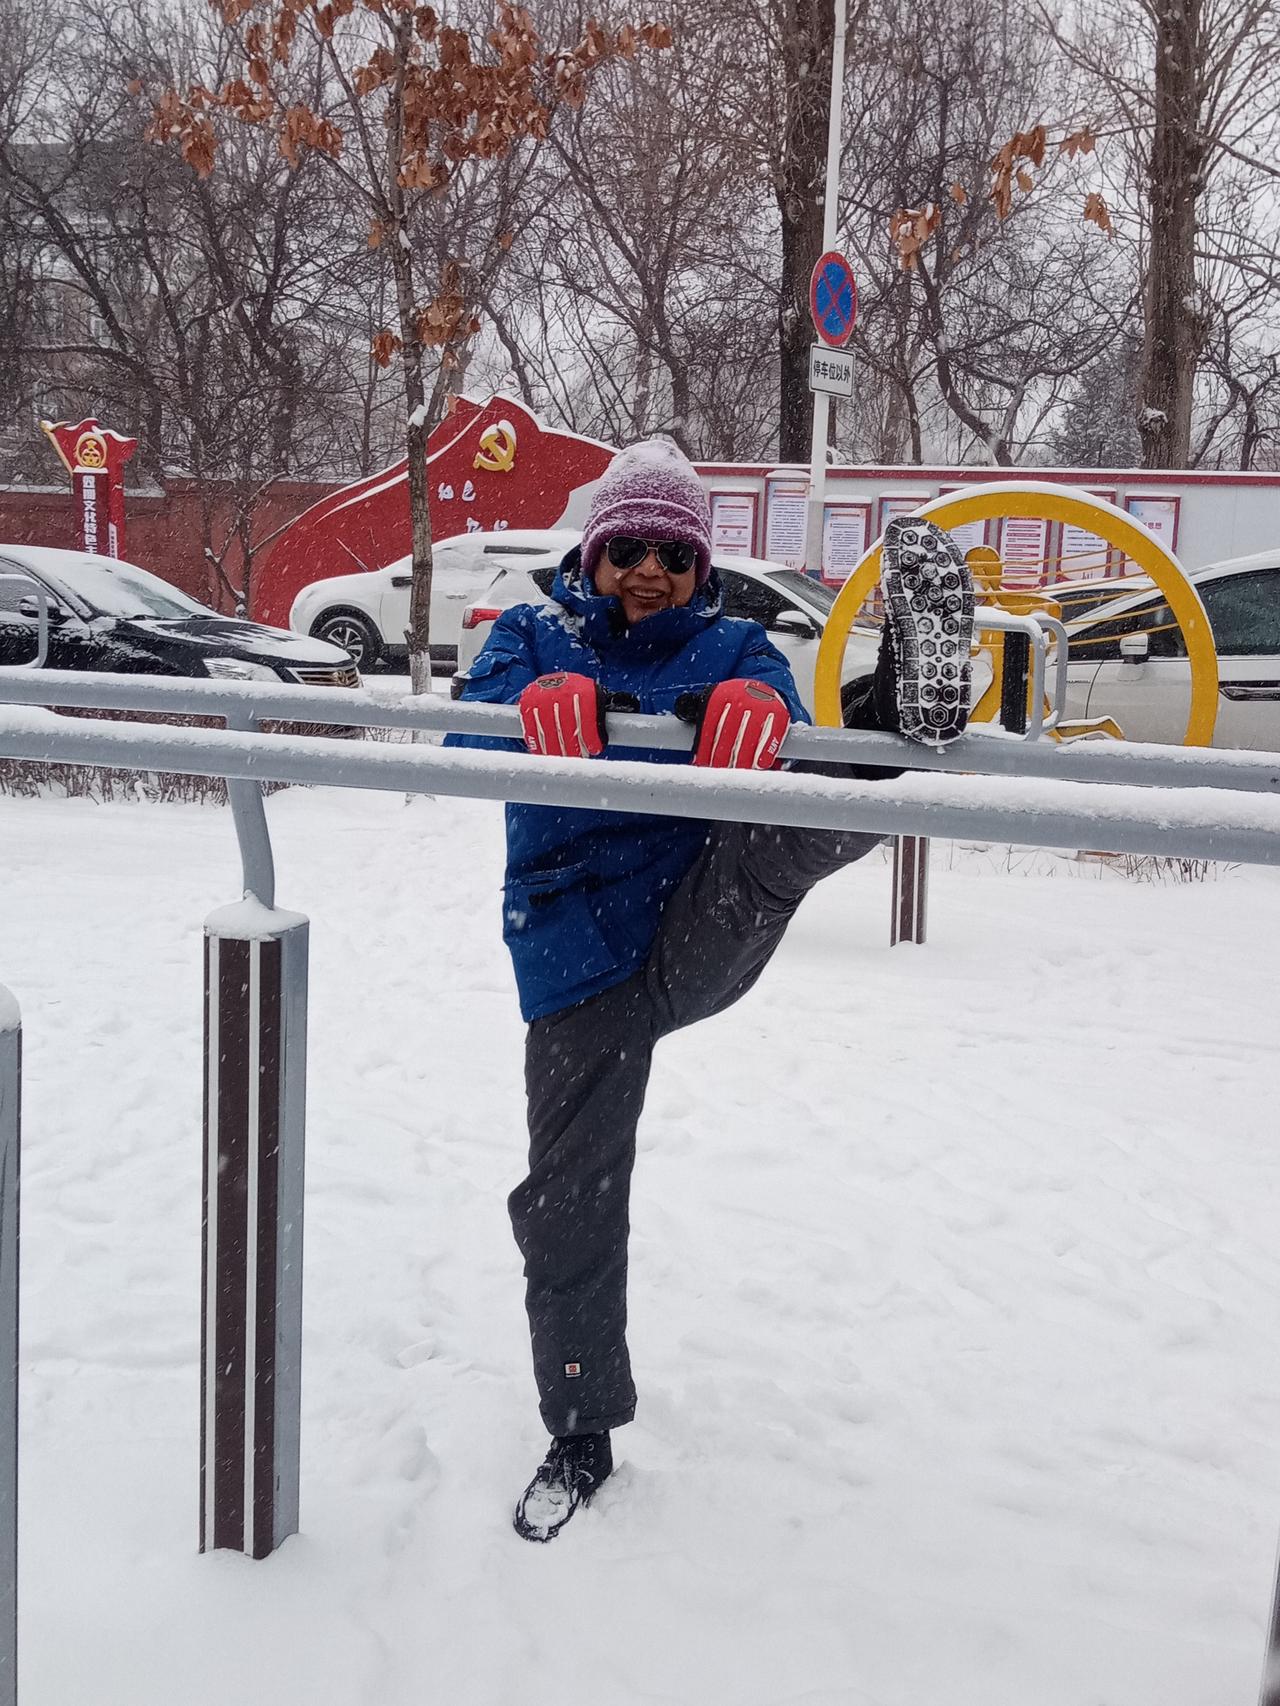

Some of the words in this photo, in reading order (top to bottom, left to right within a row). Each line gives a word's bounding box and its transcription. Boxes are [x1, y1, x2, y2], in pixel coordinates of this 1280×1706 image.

[814, 360, 851, 383] 停车位以外
